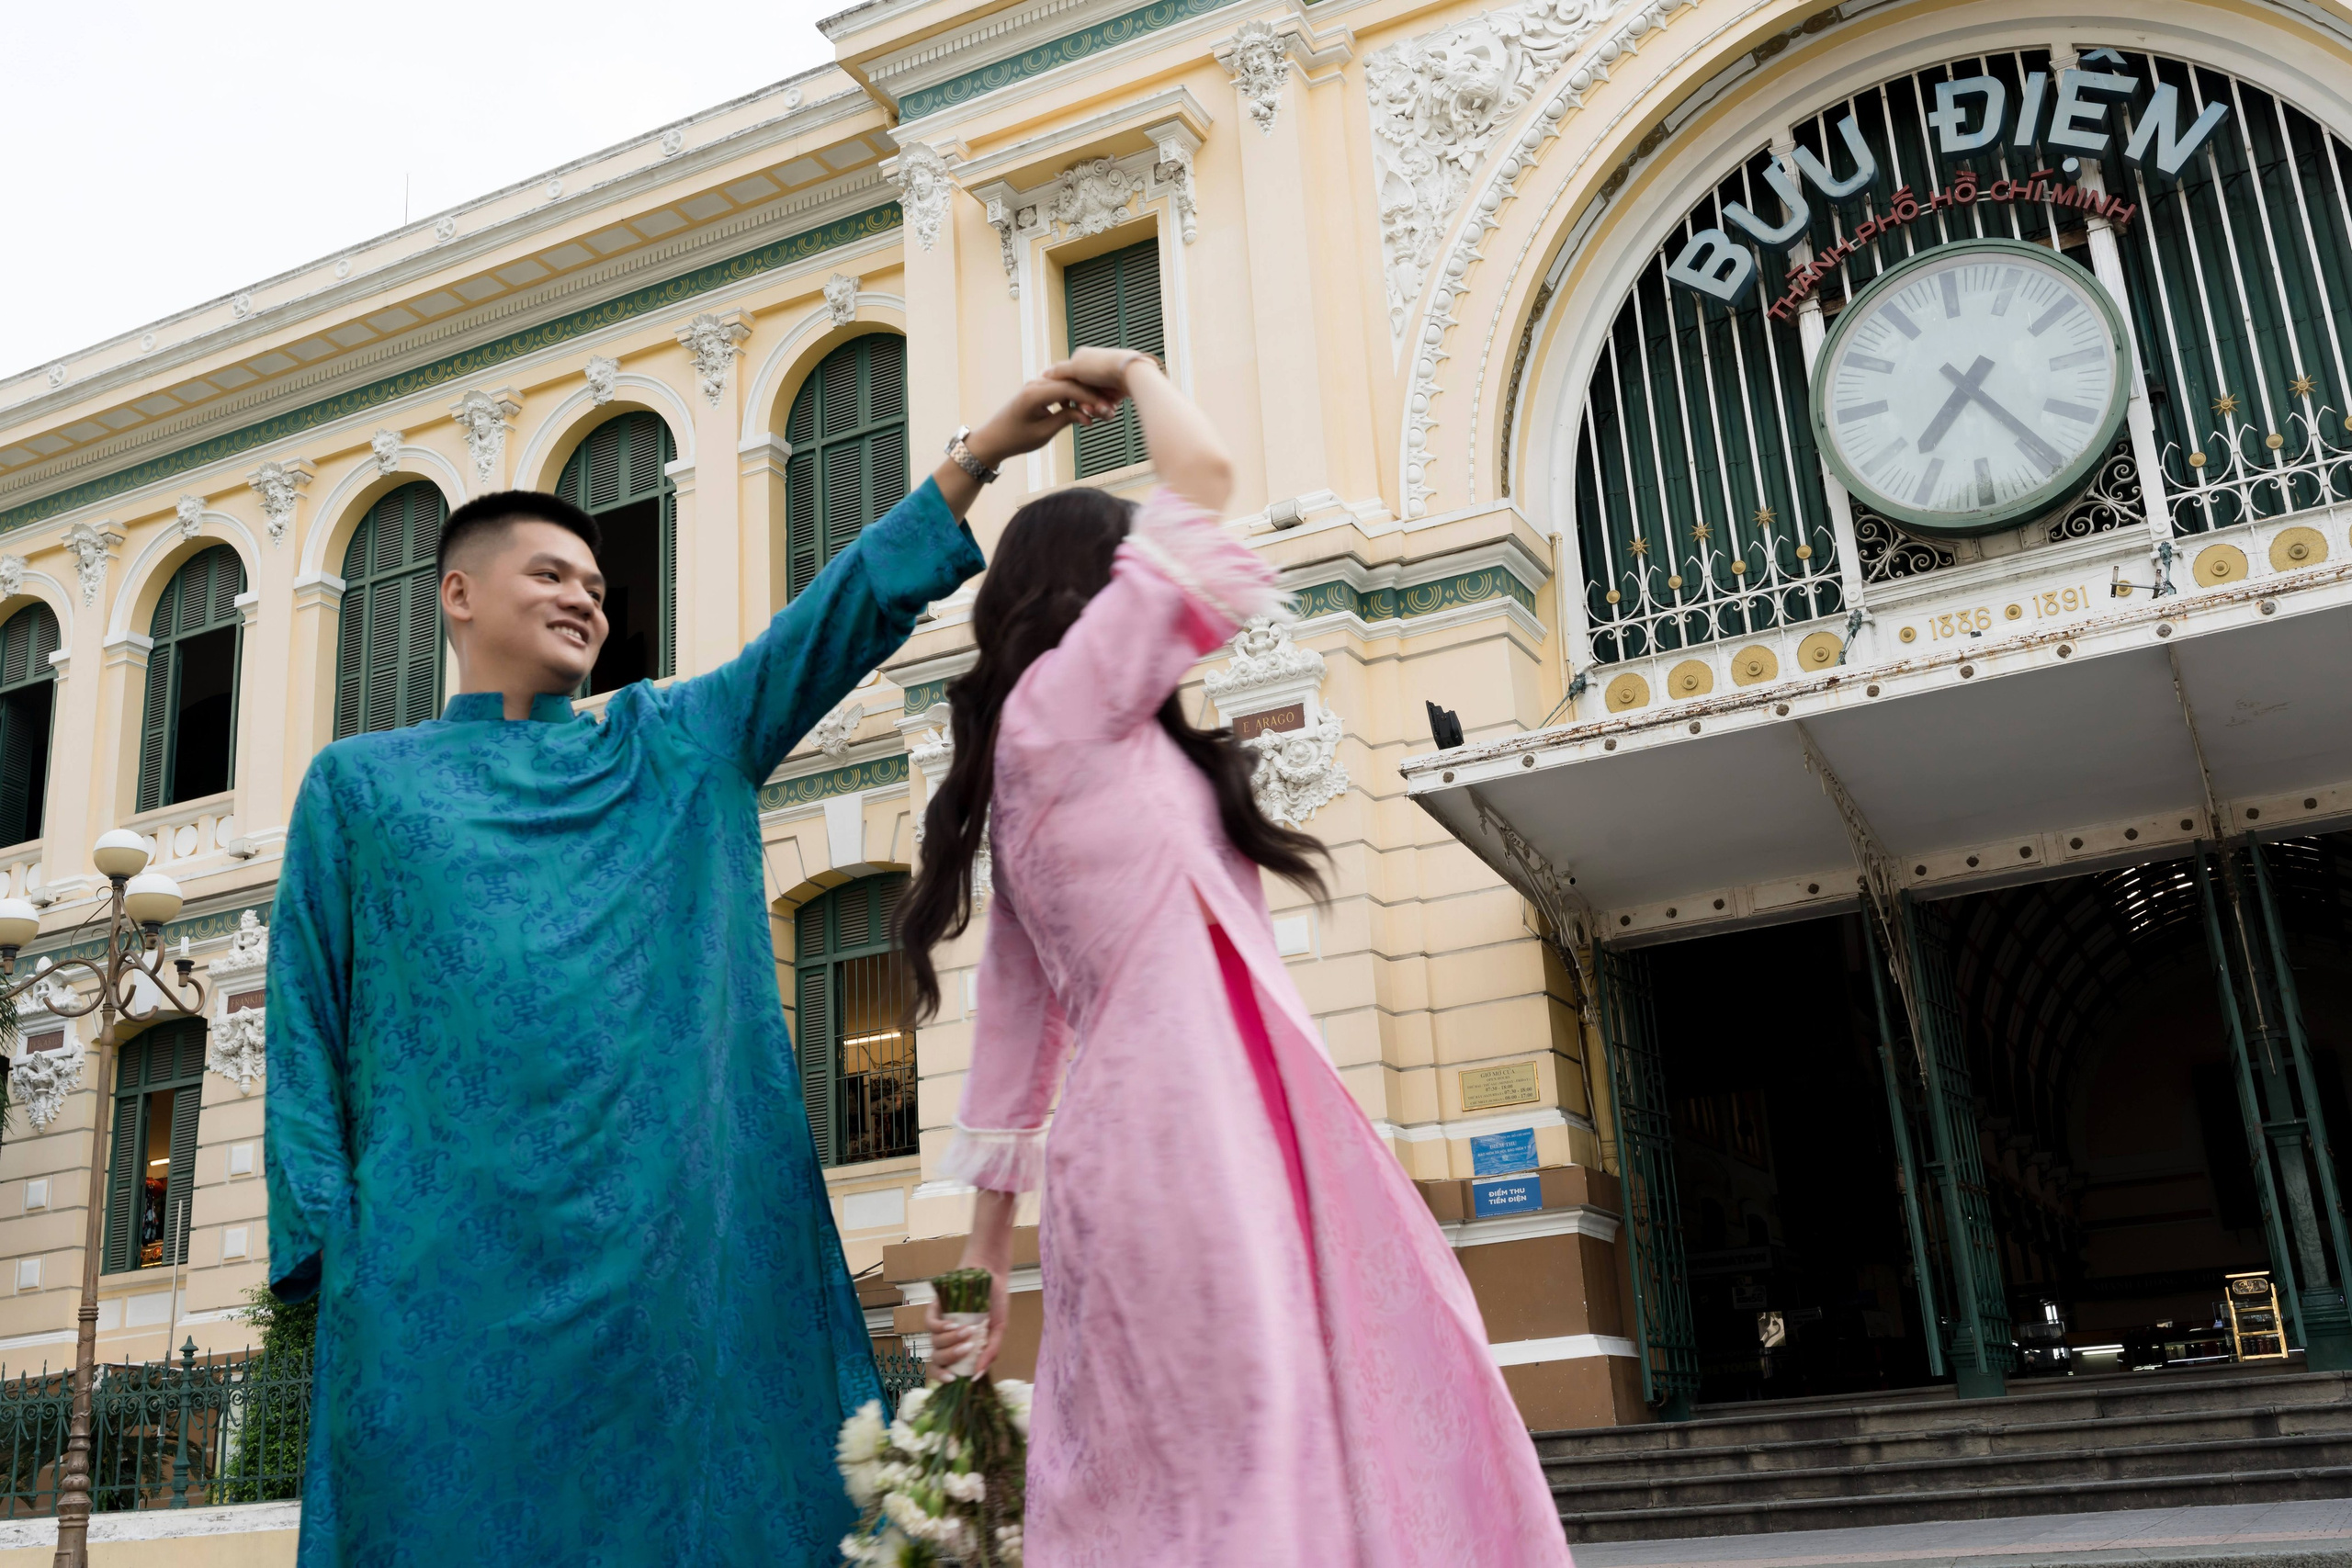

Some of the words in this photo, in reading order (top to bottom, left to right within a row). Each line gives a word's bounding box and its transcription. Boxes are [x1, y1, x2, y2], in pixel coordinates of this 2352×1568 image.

[1928, 47, 2230, 182] ĐIỆN
[1766, 236, 1853, 321] THÀNH
[1854, 184, 1920, 244] PHỐ
[1929, 170, 1978, 212] HỒ
[1990, 168, 2053, 205] CHÍ
[2050, 183, 2136, 225] MINH
[1928, 606, 1992, 640] 1886
[2032, 585, 2089, 618] 1891
[1256, 711, 1295, 731] ARAGO
